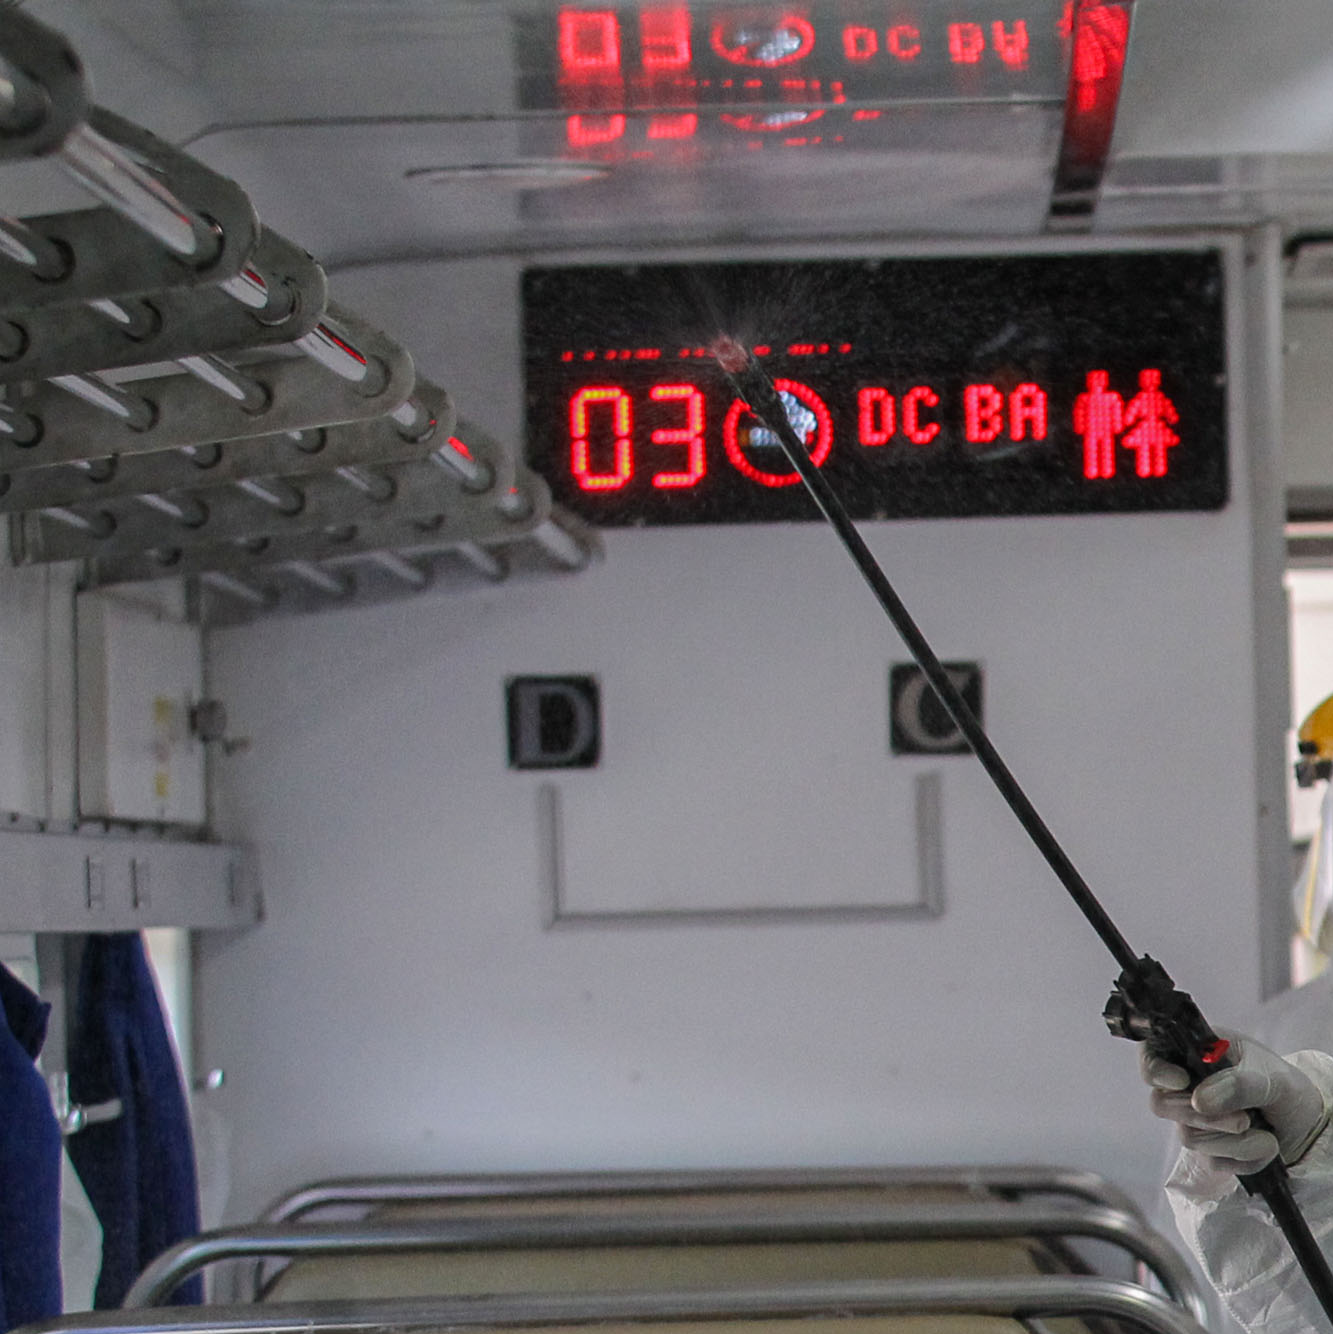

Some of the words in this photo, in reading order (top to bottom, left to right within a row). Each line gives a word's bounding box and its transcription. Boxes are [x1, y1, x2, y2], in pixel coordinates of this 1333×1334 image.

[570, 384, 706, 490] 03
[858, 386, 941, 446] DC
[963, 381, 1048, 442] BA
[517, 684, 596, 764] D
